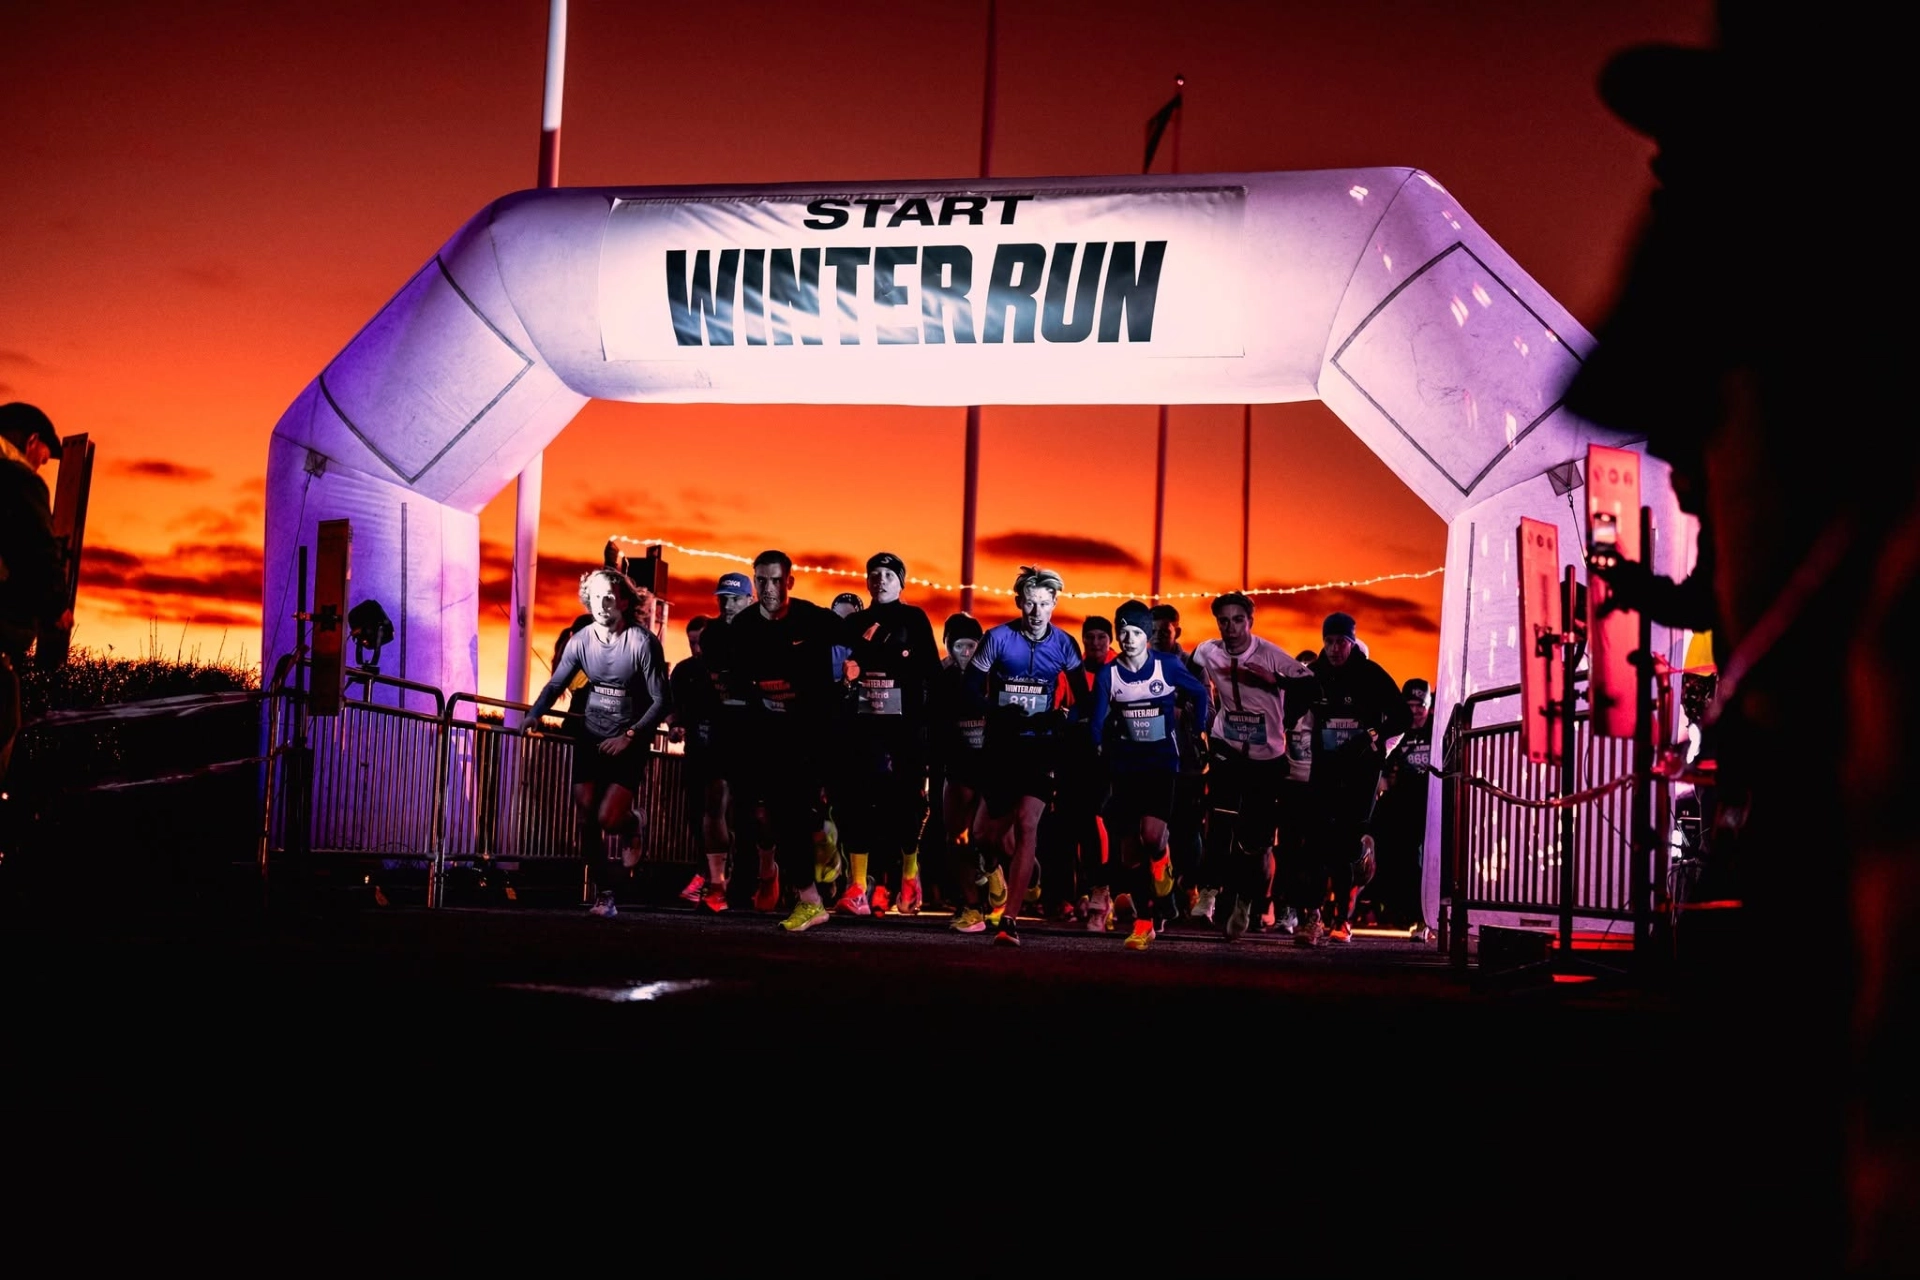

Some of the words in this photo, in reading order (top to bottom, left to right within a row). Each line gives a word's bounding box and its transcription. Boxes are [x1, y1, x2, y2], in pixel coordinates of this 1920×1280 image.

[803, 196, 1034, 230] START
[666, 242, 977, 346] WINTER
[982, 240, 1168, 344] RUN
[1009, 696, 1036, 709] 831
[1407, 753, 1429, 764] 866
